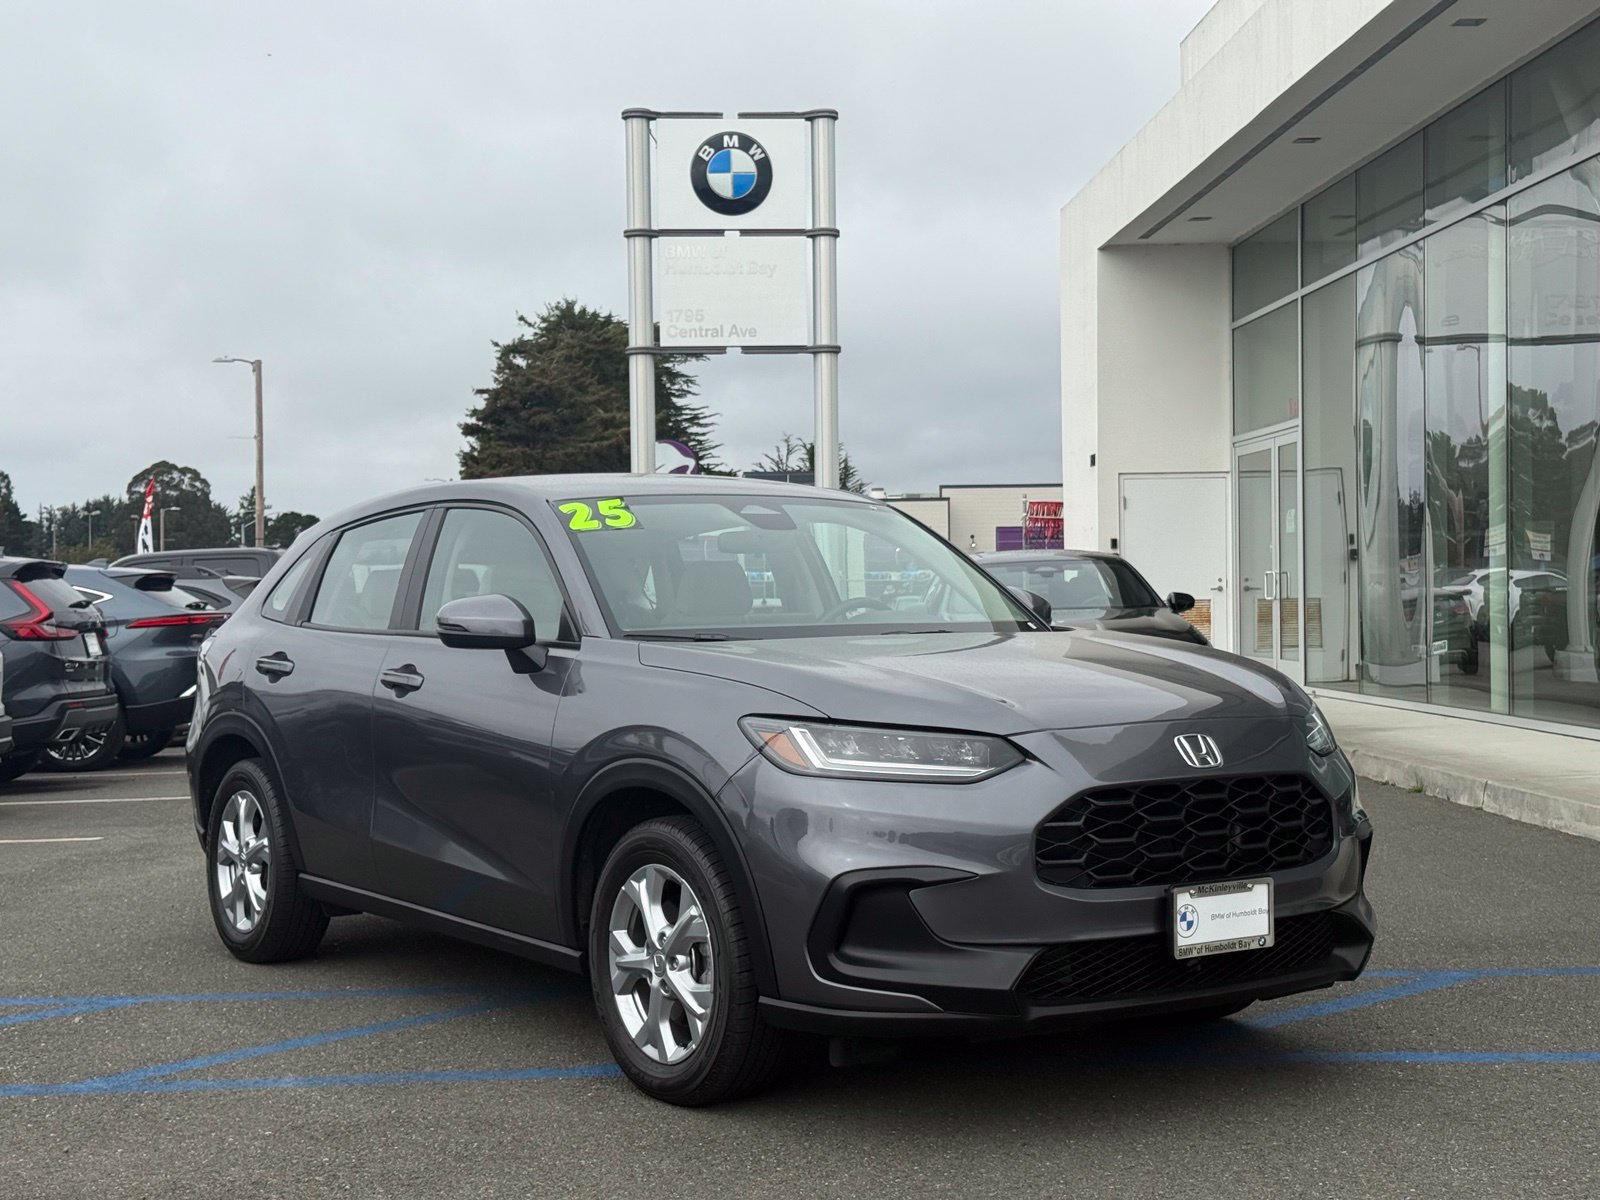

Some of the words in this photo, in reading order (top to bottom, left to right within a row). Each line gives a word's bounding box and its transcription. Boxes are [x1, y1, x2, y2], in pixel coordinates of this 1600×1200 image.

[698, 135, 765, 161] BMW
[665, 245, 706, 259] BMW
[746, 261, 778, 278] Bay
[665, 308, 705, 323] 1795
[666, 324, 724, 338] Central
[728, 324, 758, 338] Ave
[558, 498, 636, 531] 25
[1197, 881, 1248, 894] McKinleyville
[1210, 913, 1225, 921] BMW
[1226, 911, 1232, 919] of
[1232, 909, 1257, 918] Humboldt
[1197, 945, 1203, 954] of
[1204, 942, 1237, 953] Humboldt
